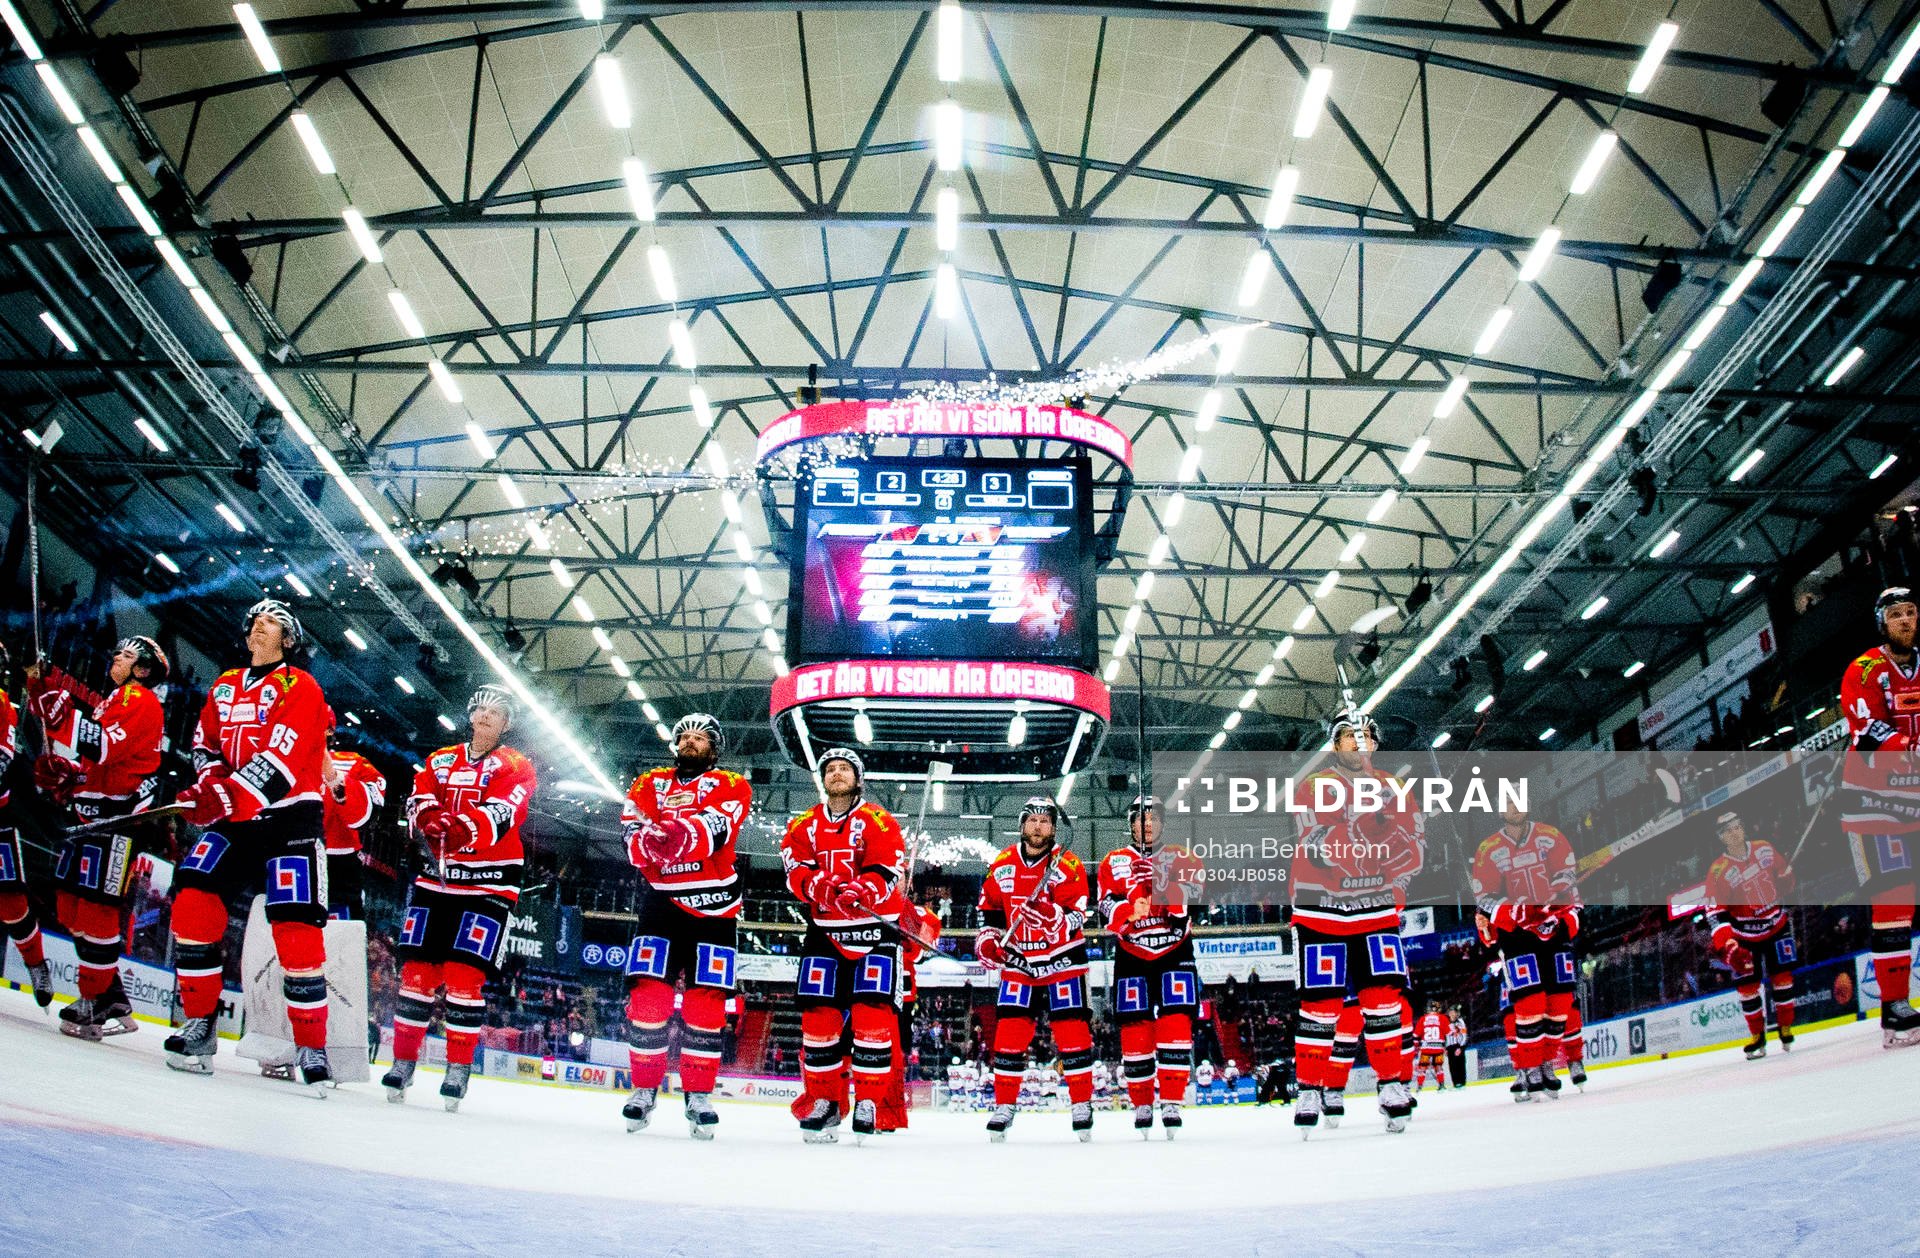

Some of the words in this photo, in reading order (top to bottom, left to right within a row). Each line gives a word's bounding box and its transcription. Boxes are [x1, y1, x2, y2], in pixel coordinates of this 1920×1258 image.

[947, 408, 968, 432] VI
[973, 408, 1021, 433] SOM
[796, 667, 833, 700] DET
[870, 667, 893, 693] VI
[897, 667, 949, 694] SOM
[990, 663, 1075, 701] ÖREBRO
[105, 721, 127, 745] 12
[269, 723, 299, 756] 85
[509, 784, 528, 806] 5
[1342, 876, 1384, 889] ÖREBRO
[1198, 940, 1277, 955] Vintergatan
[1423, 1026, 1441, 1041] 20
[565, 1066, 607, 1085] ELON
[758, 1086, 798, 1098] Nolato
